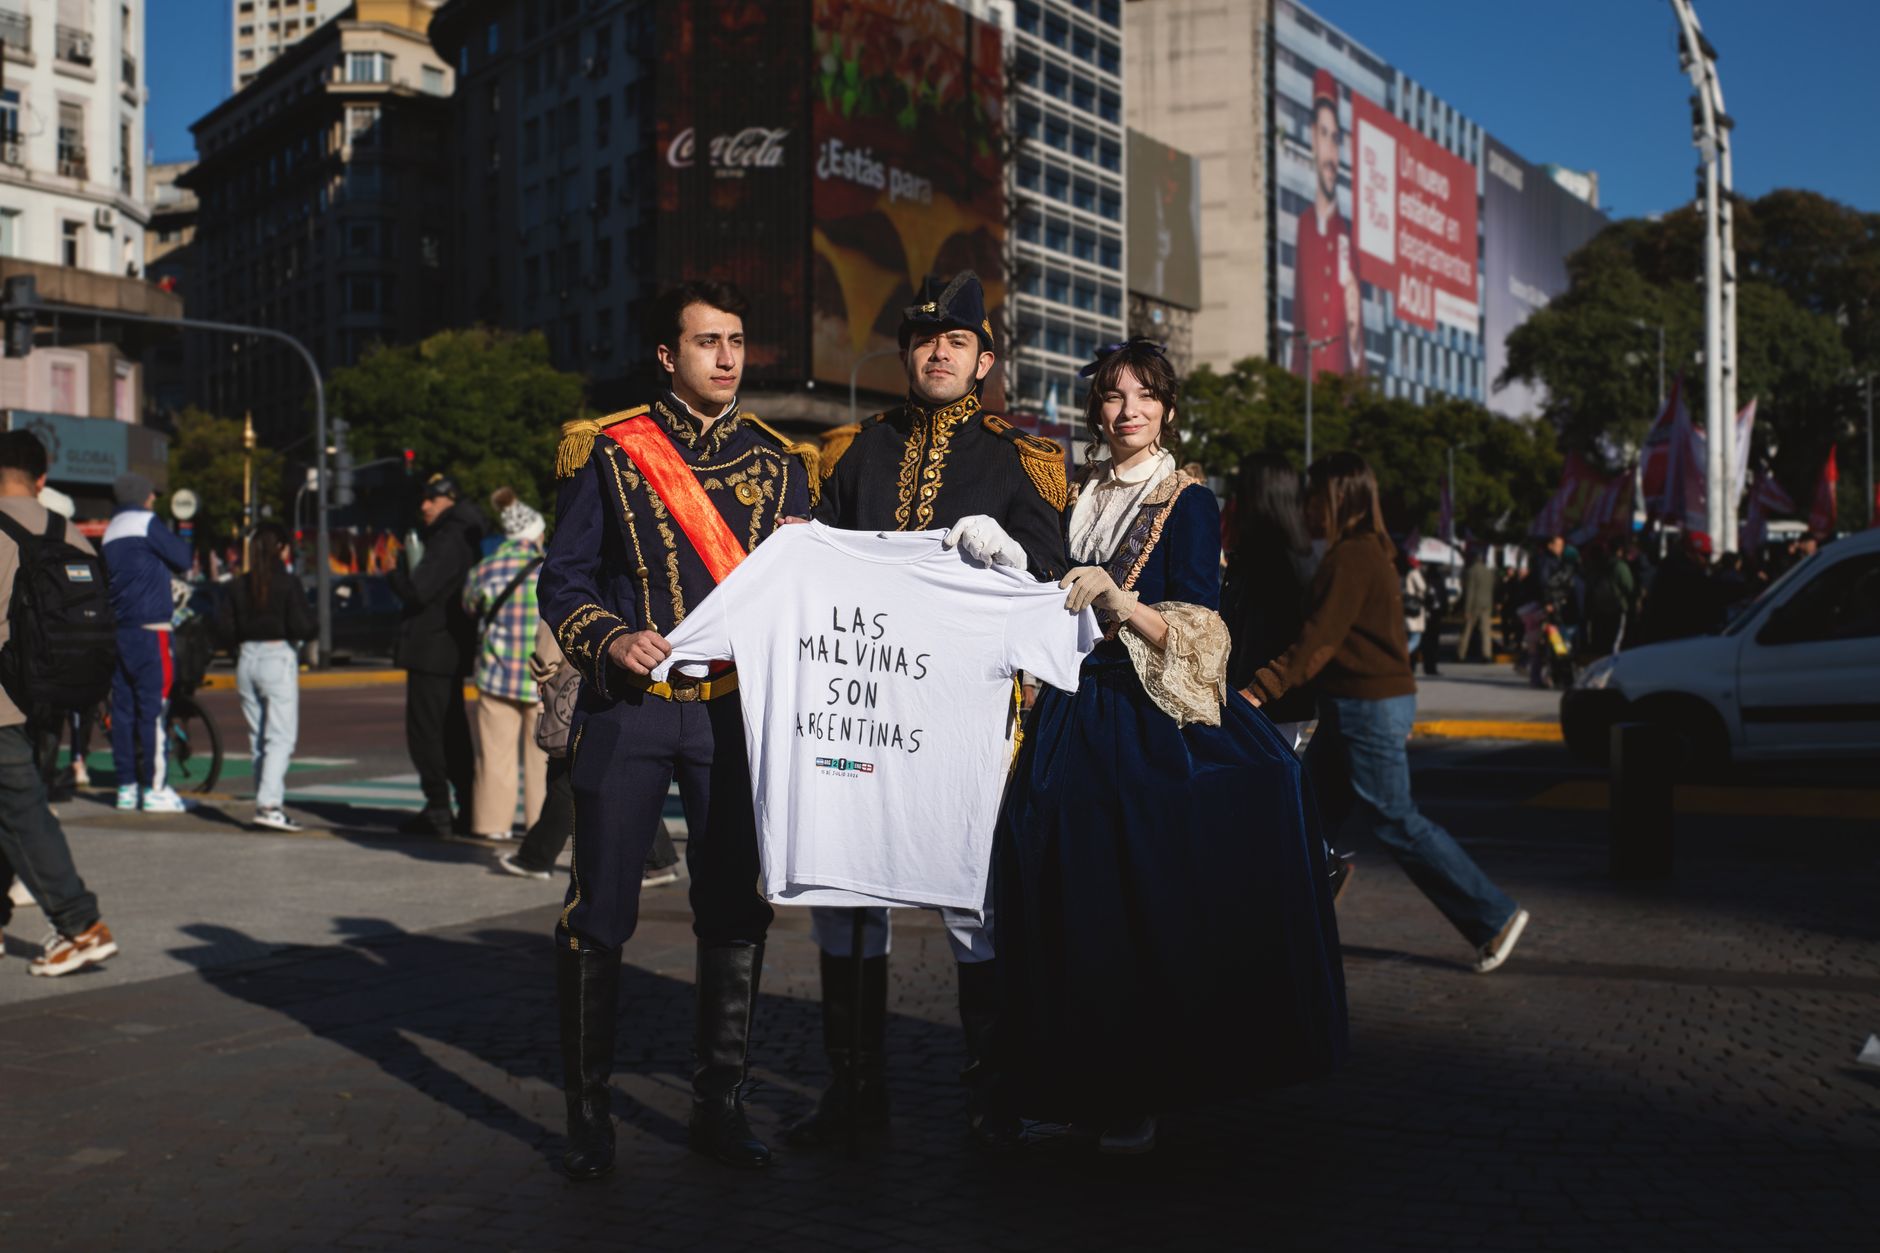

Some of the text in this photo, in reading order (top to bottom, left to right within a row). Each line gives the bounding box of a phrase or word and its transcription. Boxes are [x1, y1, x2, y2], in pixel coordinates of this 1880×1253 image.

[816, 137, 933, 206] ¿Estás para
[833, 606, 888, 640] LAS
[826, 677, 878, 709] SON
